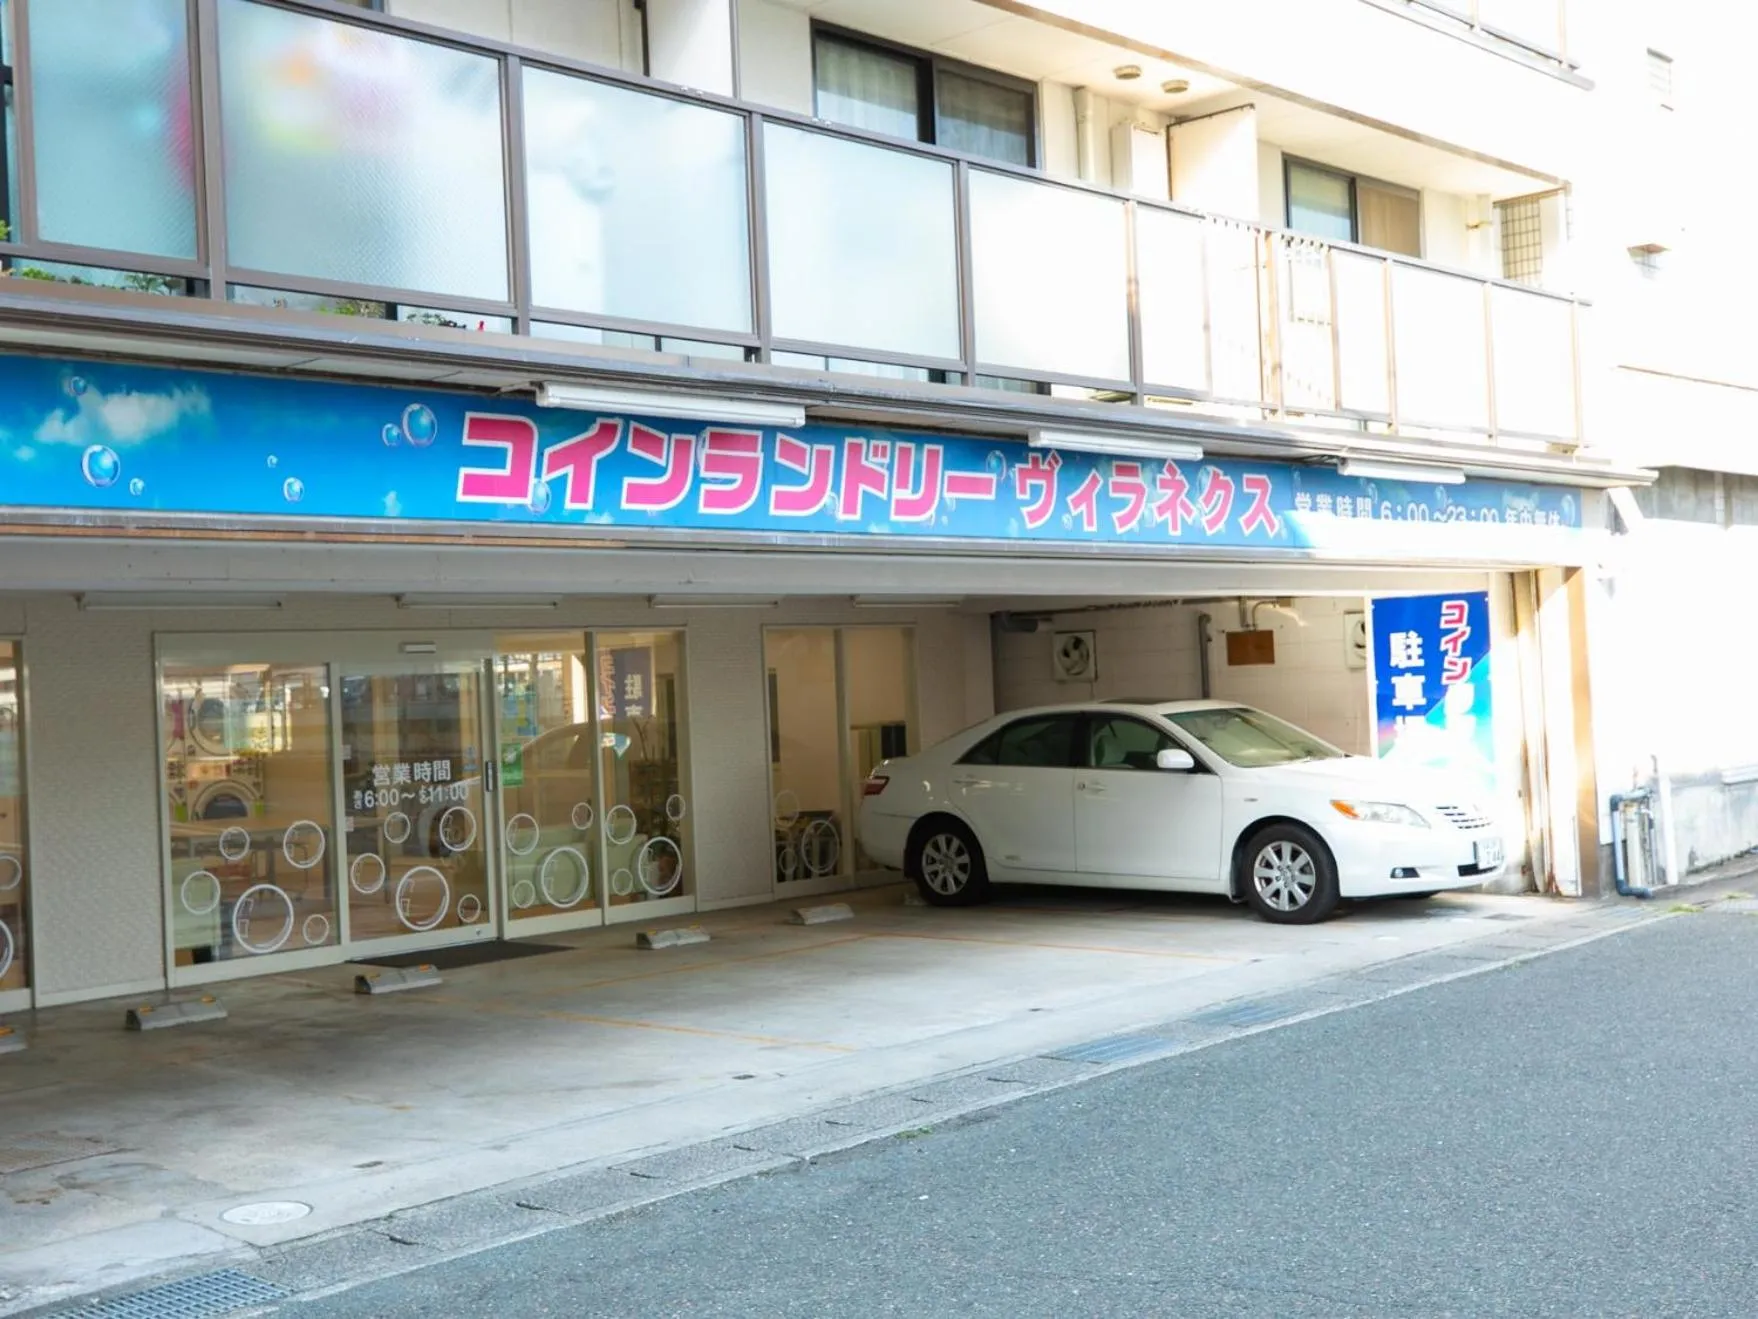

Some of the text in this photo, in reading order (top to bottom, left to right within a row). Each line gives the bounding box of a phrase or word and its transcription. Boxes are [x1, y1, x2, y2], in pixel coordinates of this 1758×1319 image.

[457, 411, 1281, 538] コインランドリー ヴィラネクス
[372, 759, 451, 786] 営業時間
